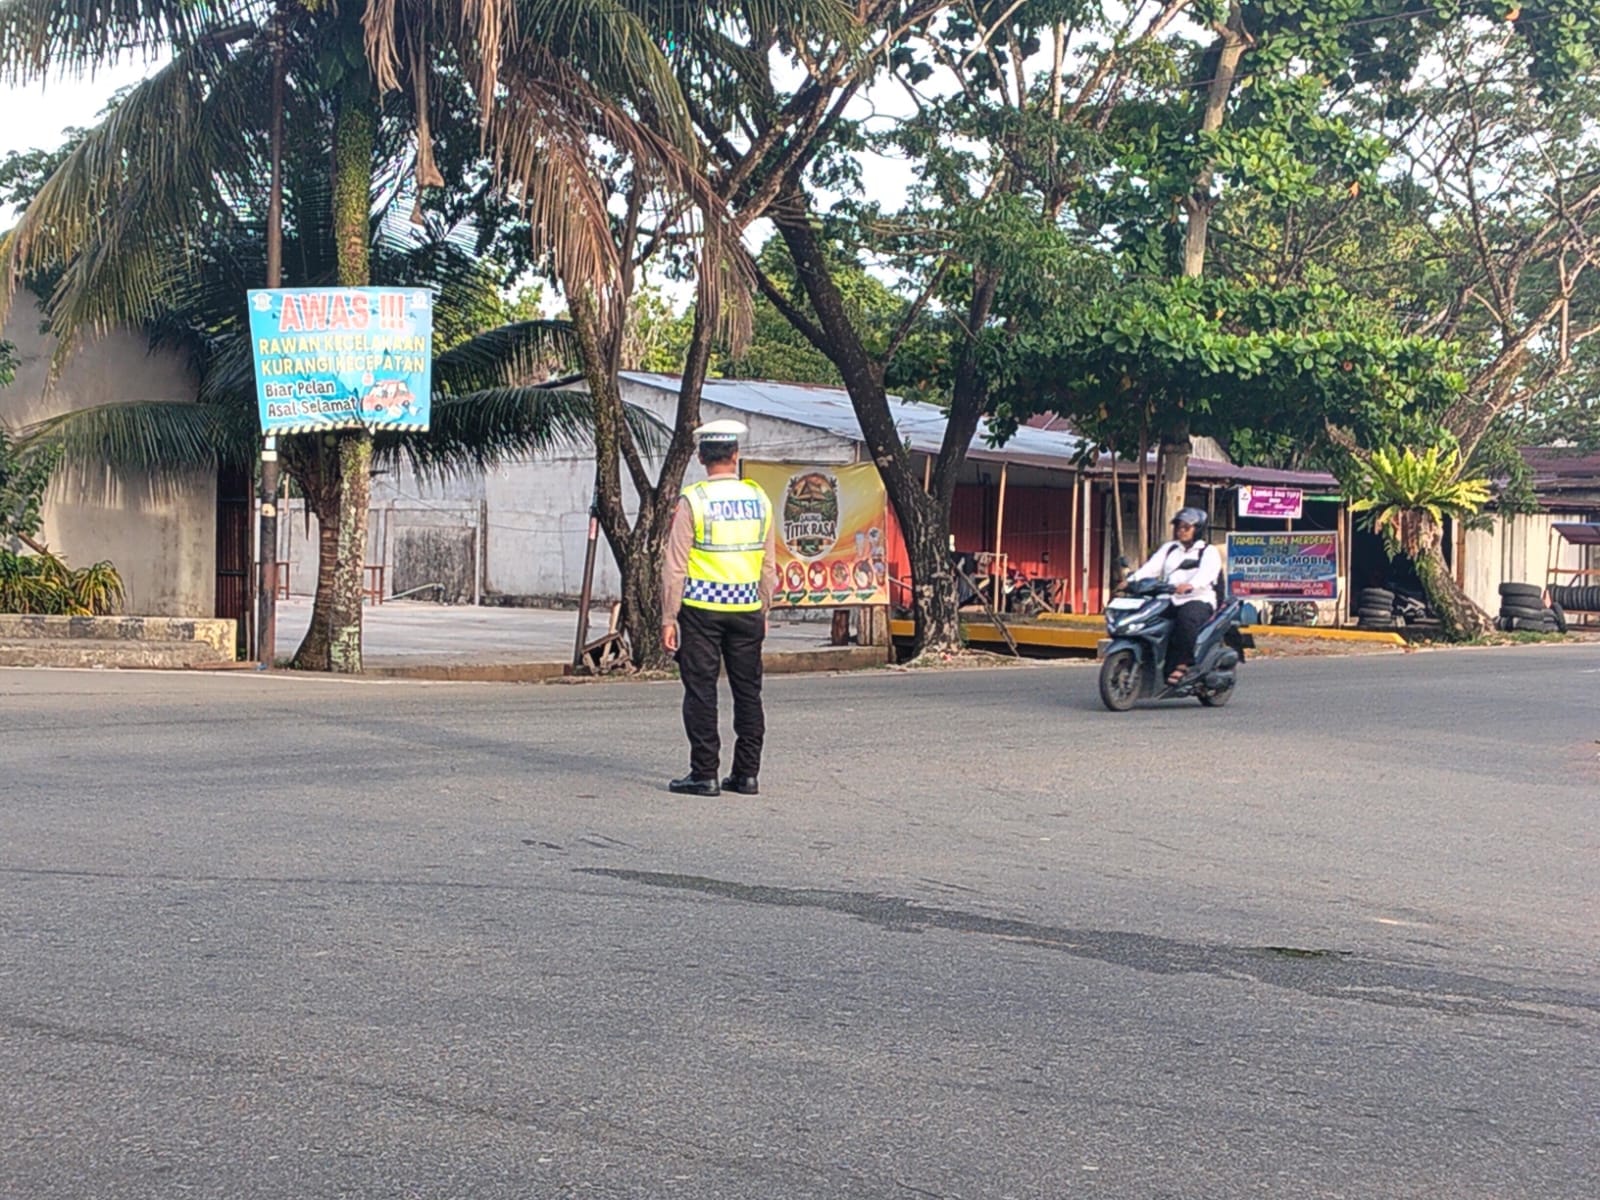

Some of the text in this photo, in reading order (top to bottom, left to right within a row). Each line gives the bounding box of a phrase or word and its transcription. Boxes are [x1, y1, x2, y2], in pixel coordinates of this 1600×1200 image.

[279, 293, 370, 332] AWAS
[259, 337, 321, 355] RAWAN
[261, 355, 425, 376] KURANGI KECEPATAN
[265, 380, 335, 398] Biar Pelan
[268, 397, 357, 417] Asal Selamat
[711, 500, 760, 520] POLISI
[784, 521, 836, 540] TITIK RASA
[1232, 536, 1333, 545] TAMBAL BAN MERDEKA
[1235, 556, 1275, 565] MOTOR
[1292, 556, 1330, 565] MOBIL
